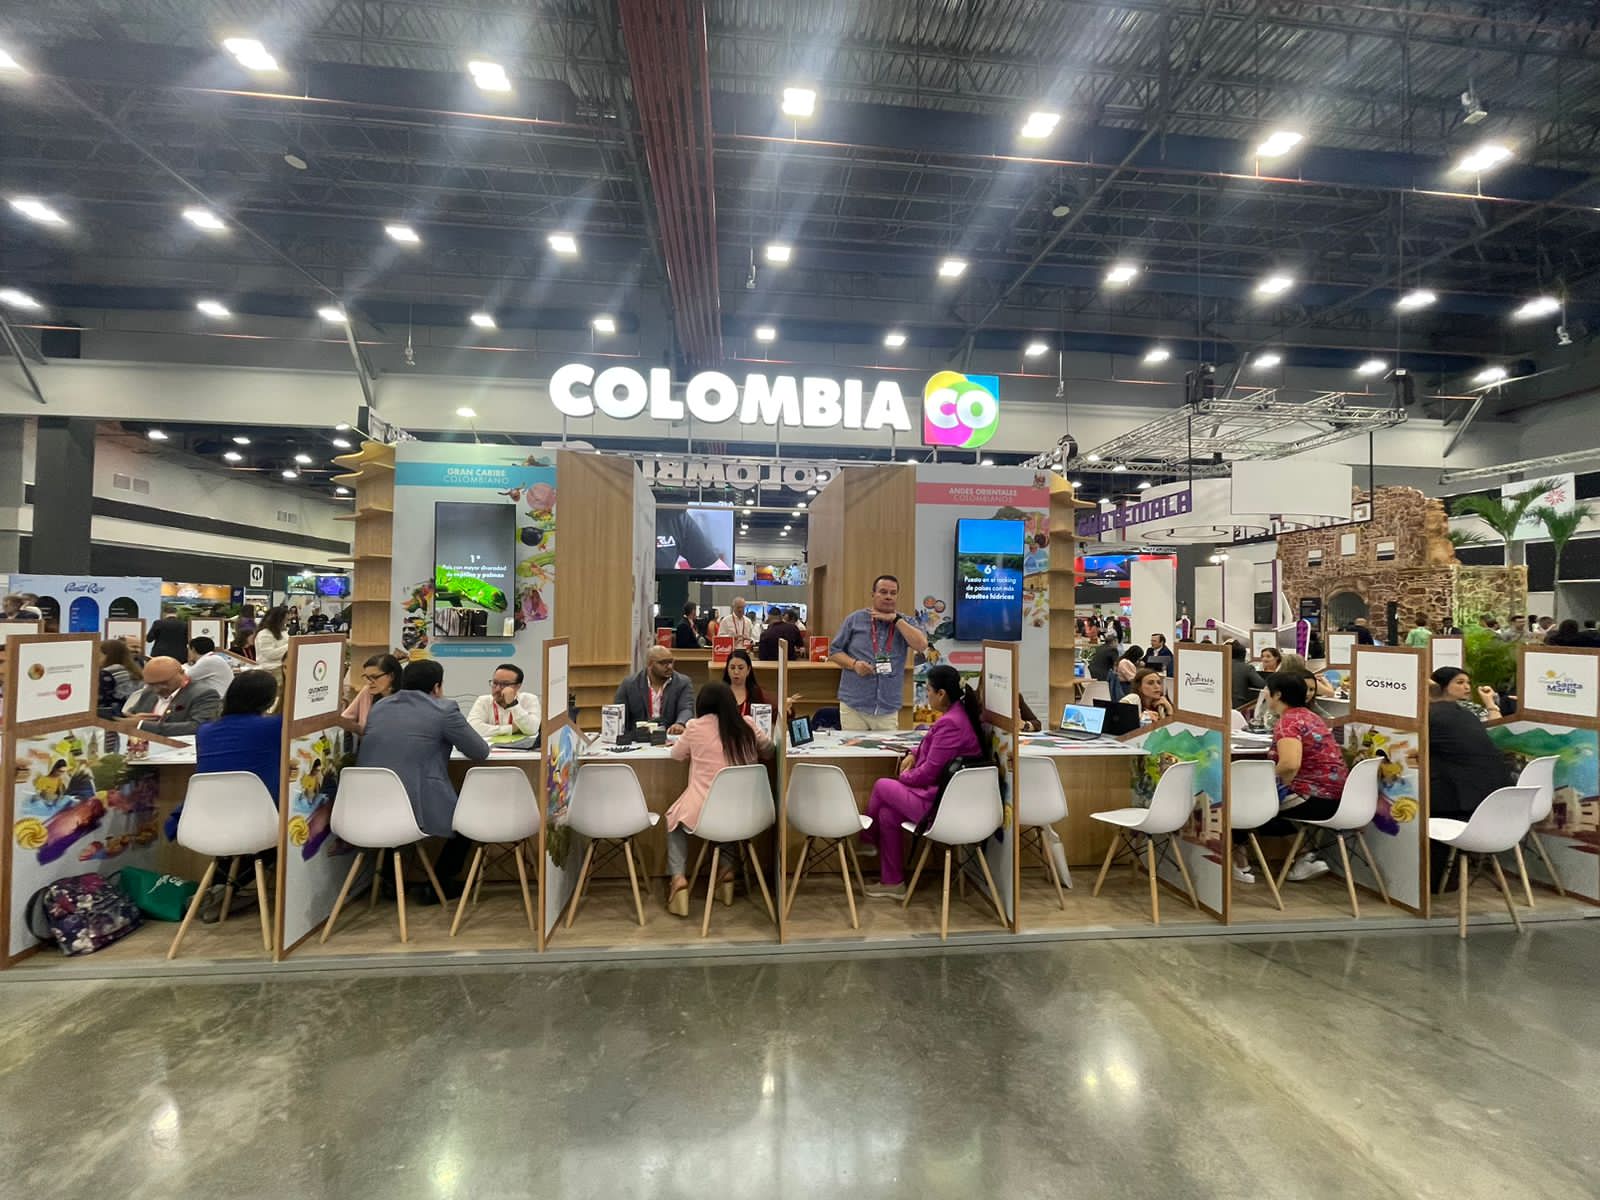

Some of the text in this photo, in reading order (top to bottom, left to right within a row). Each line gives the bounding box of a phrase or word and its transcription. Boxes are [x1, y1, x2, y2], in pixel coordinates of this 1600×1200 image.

[549, 363, 911, 431] COLOMBIA
[925, 387, 998, 430] CO
[447, 468, 473, 476] GRAN
[1366, 679, 1408, 691] COSMOS
